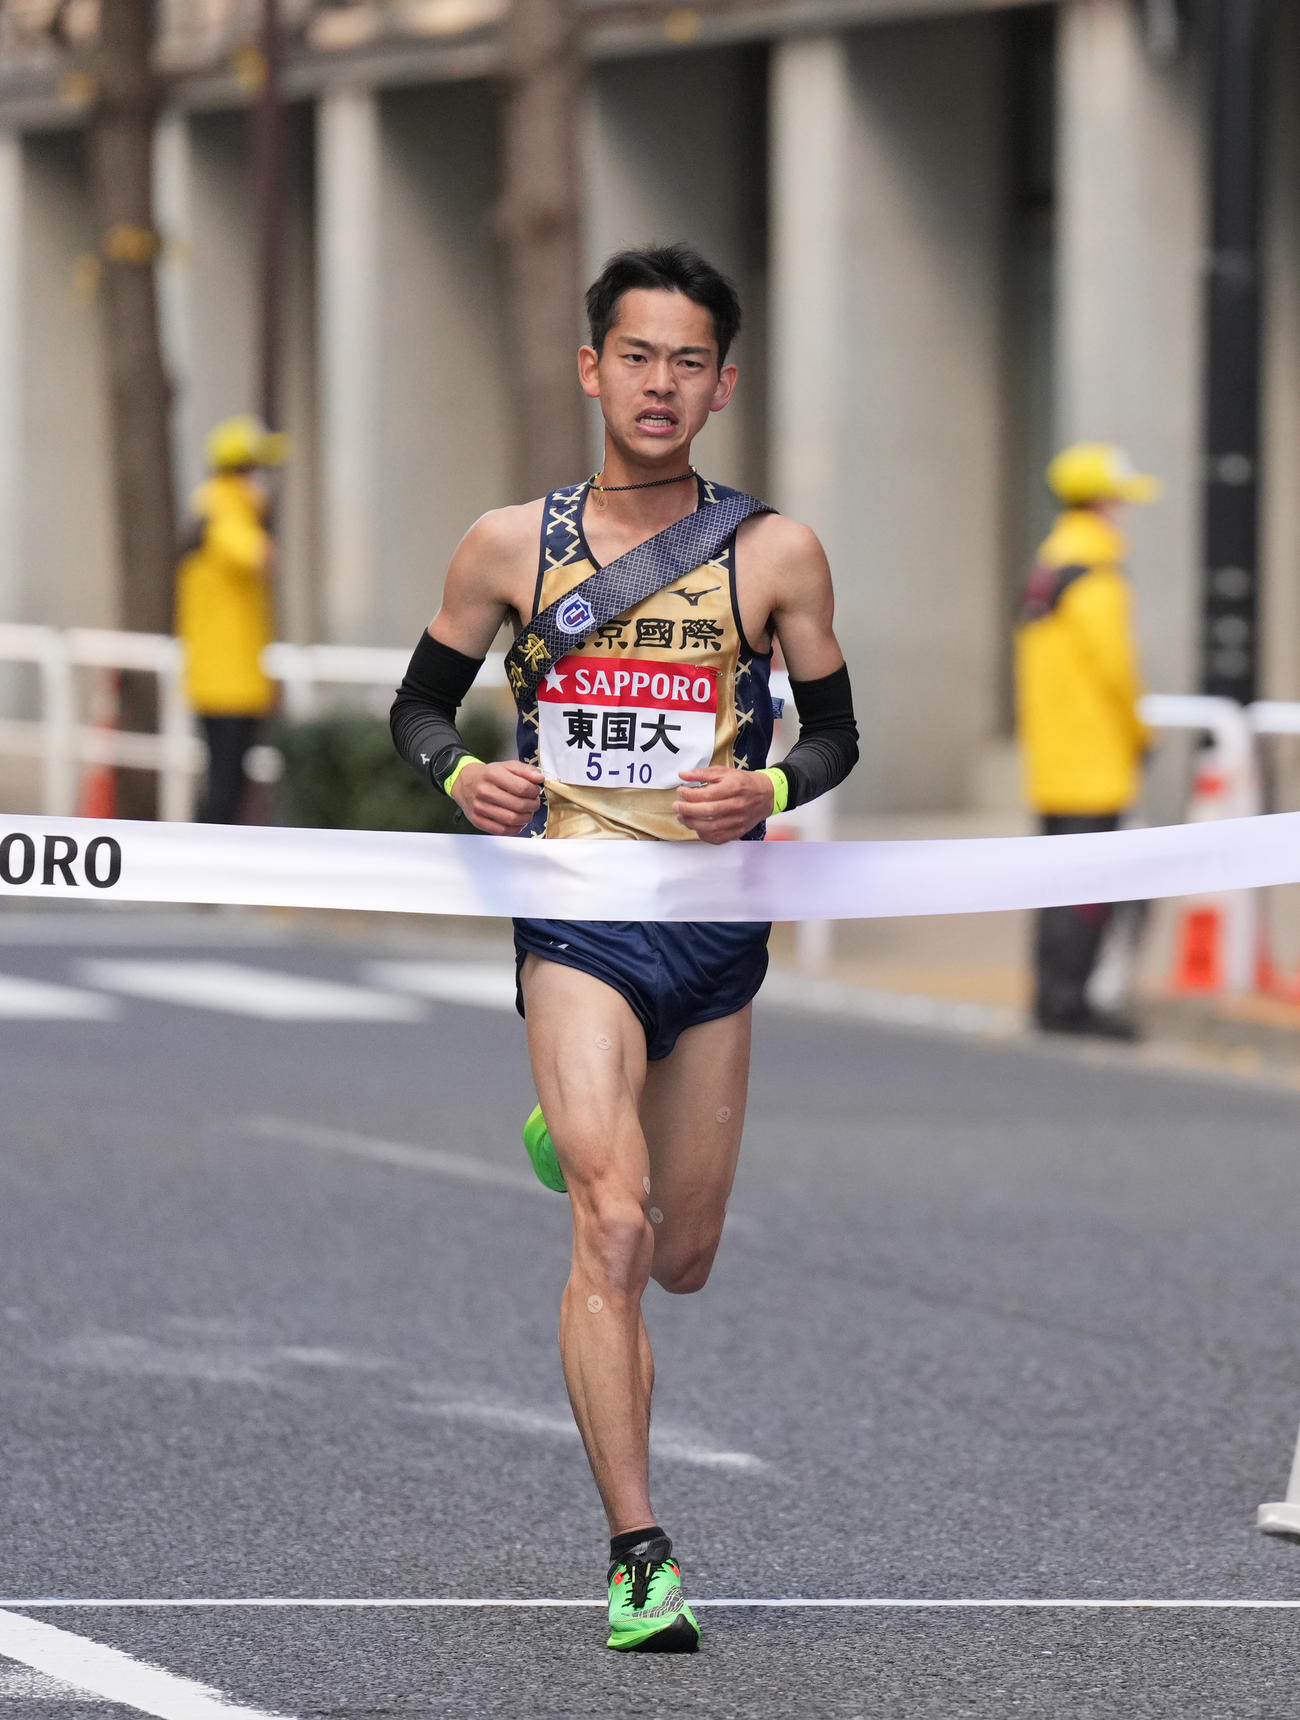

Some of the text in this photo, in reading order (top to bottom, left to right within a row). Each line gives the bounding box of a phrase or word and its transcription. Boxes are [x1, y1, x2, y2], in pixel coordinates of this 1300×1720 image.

[576, 618, 724, 651] 京國際
[575, 669, 711, 703] SAPPORO
[562, 708, 682, 754] 東国大
[0, 832, 122, 888] ORO
